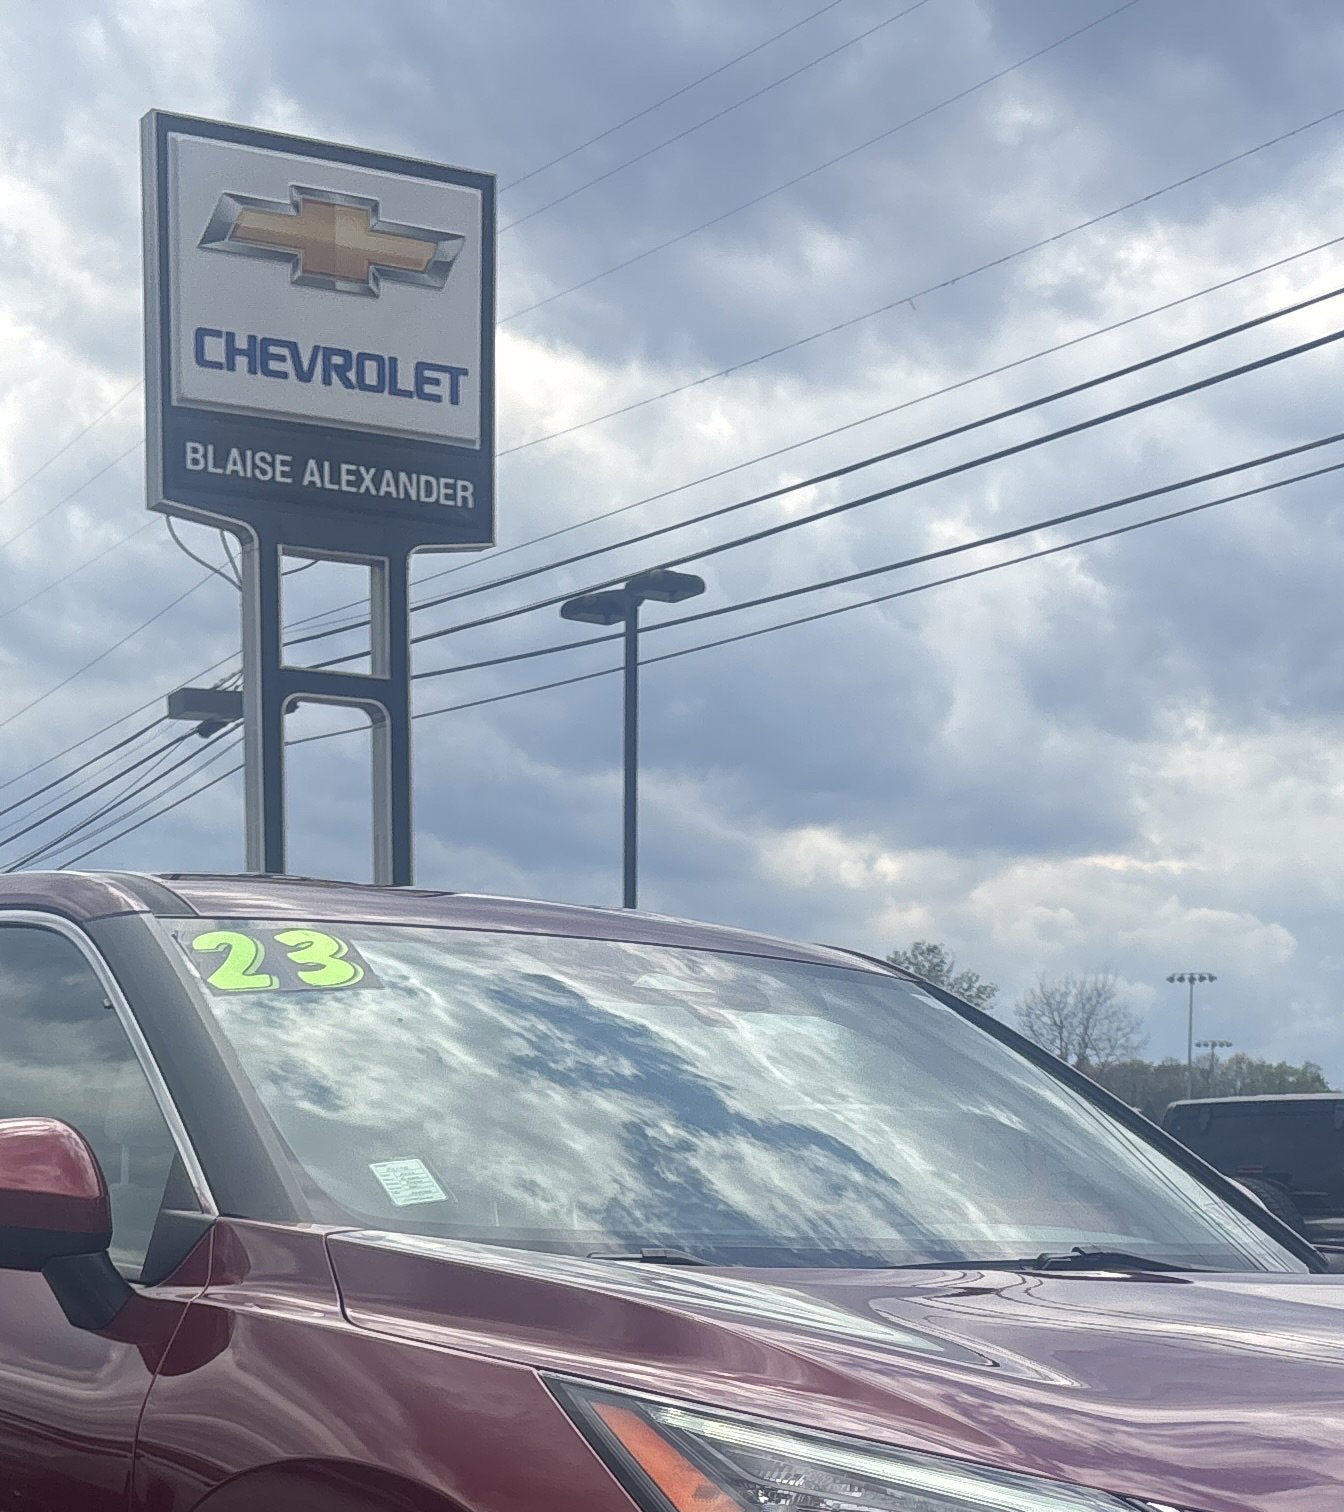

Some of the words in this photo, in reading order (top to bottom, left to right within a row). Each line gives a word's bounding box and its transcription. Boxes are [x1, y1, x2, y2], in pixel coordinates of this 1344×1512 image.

[194, 326, 469, 405] CHEVROLET
[185, 441, 293, 484] BLAISE
[302, 459, 475, 509] ALEXANDER
[192, 928, 365, 991] 23
